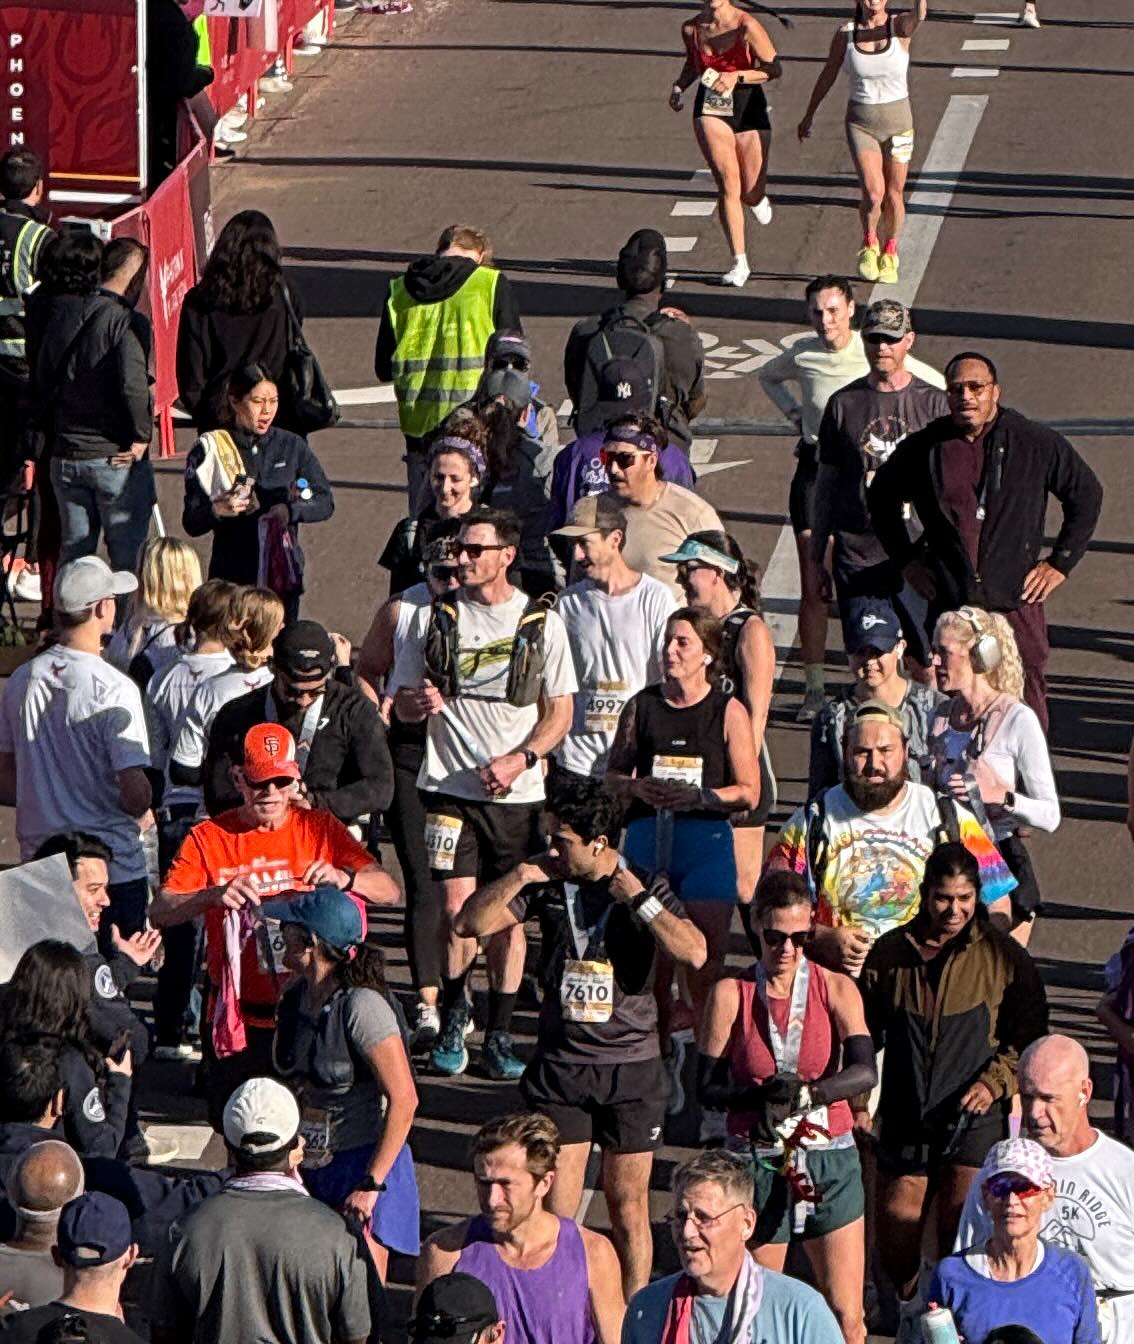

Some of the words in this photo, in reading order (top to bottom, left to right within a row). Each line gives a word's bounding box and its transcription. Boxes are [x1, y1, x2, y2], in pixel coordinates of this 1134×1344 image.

[564, 982, 609, 1002] 7610
[1061, 1205, 1080, 1221] 5K
[1078, 1188, 1112, 1229] RIDGE
